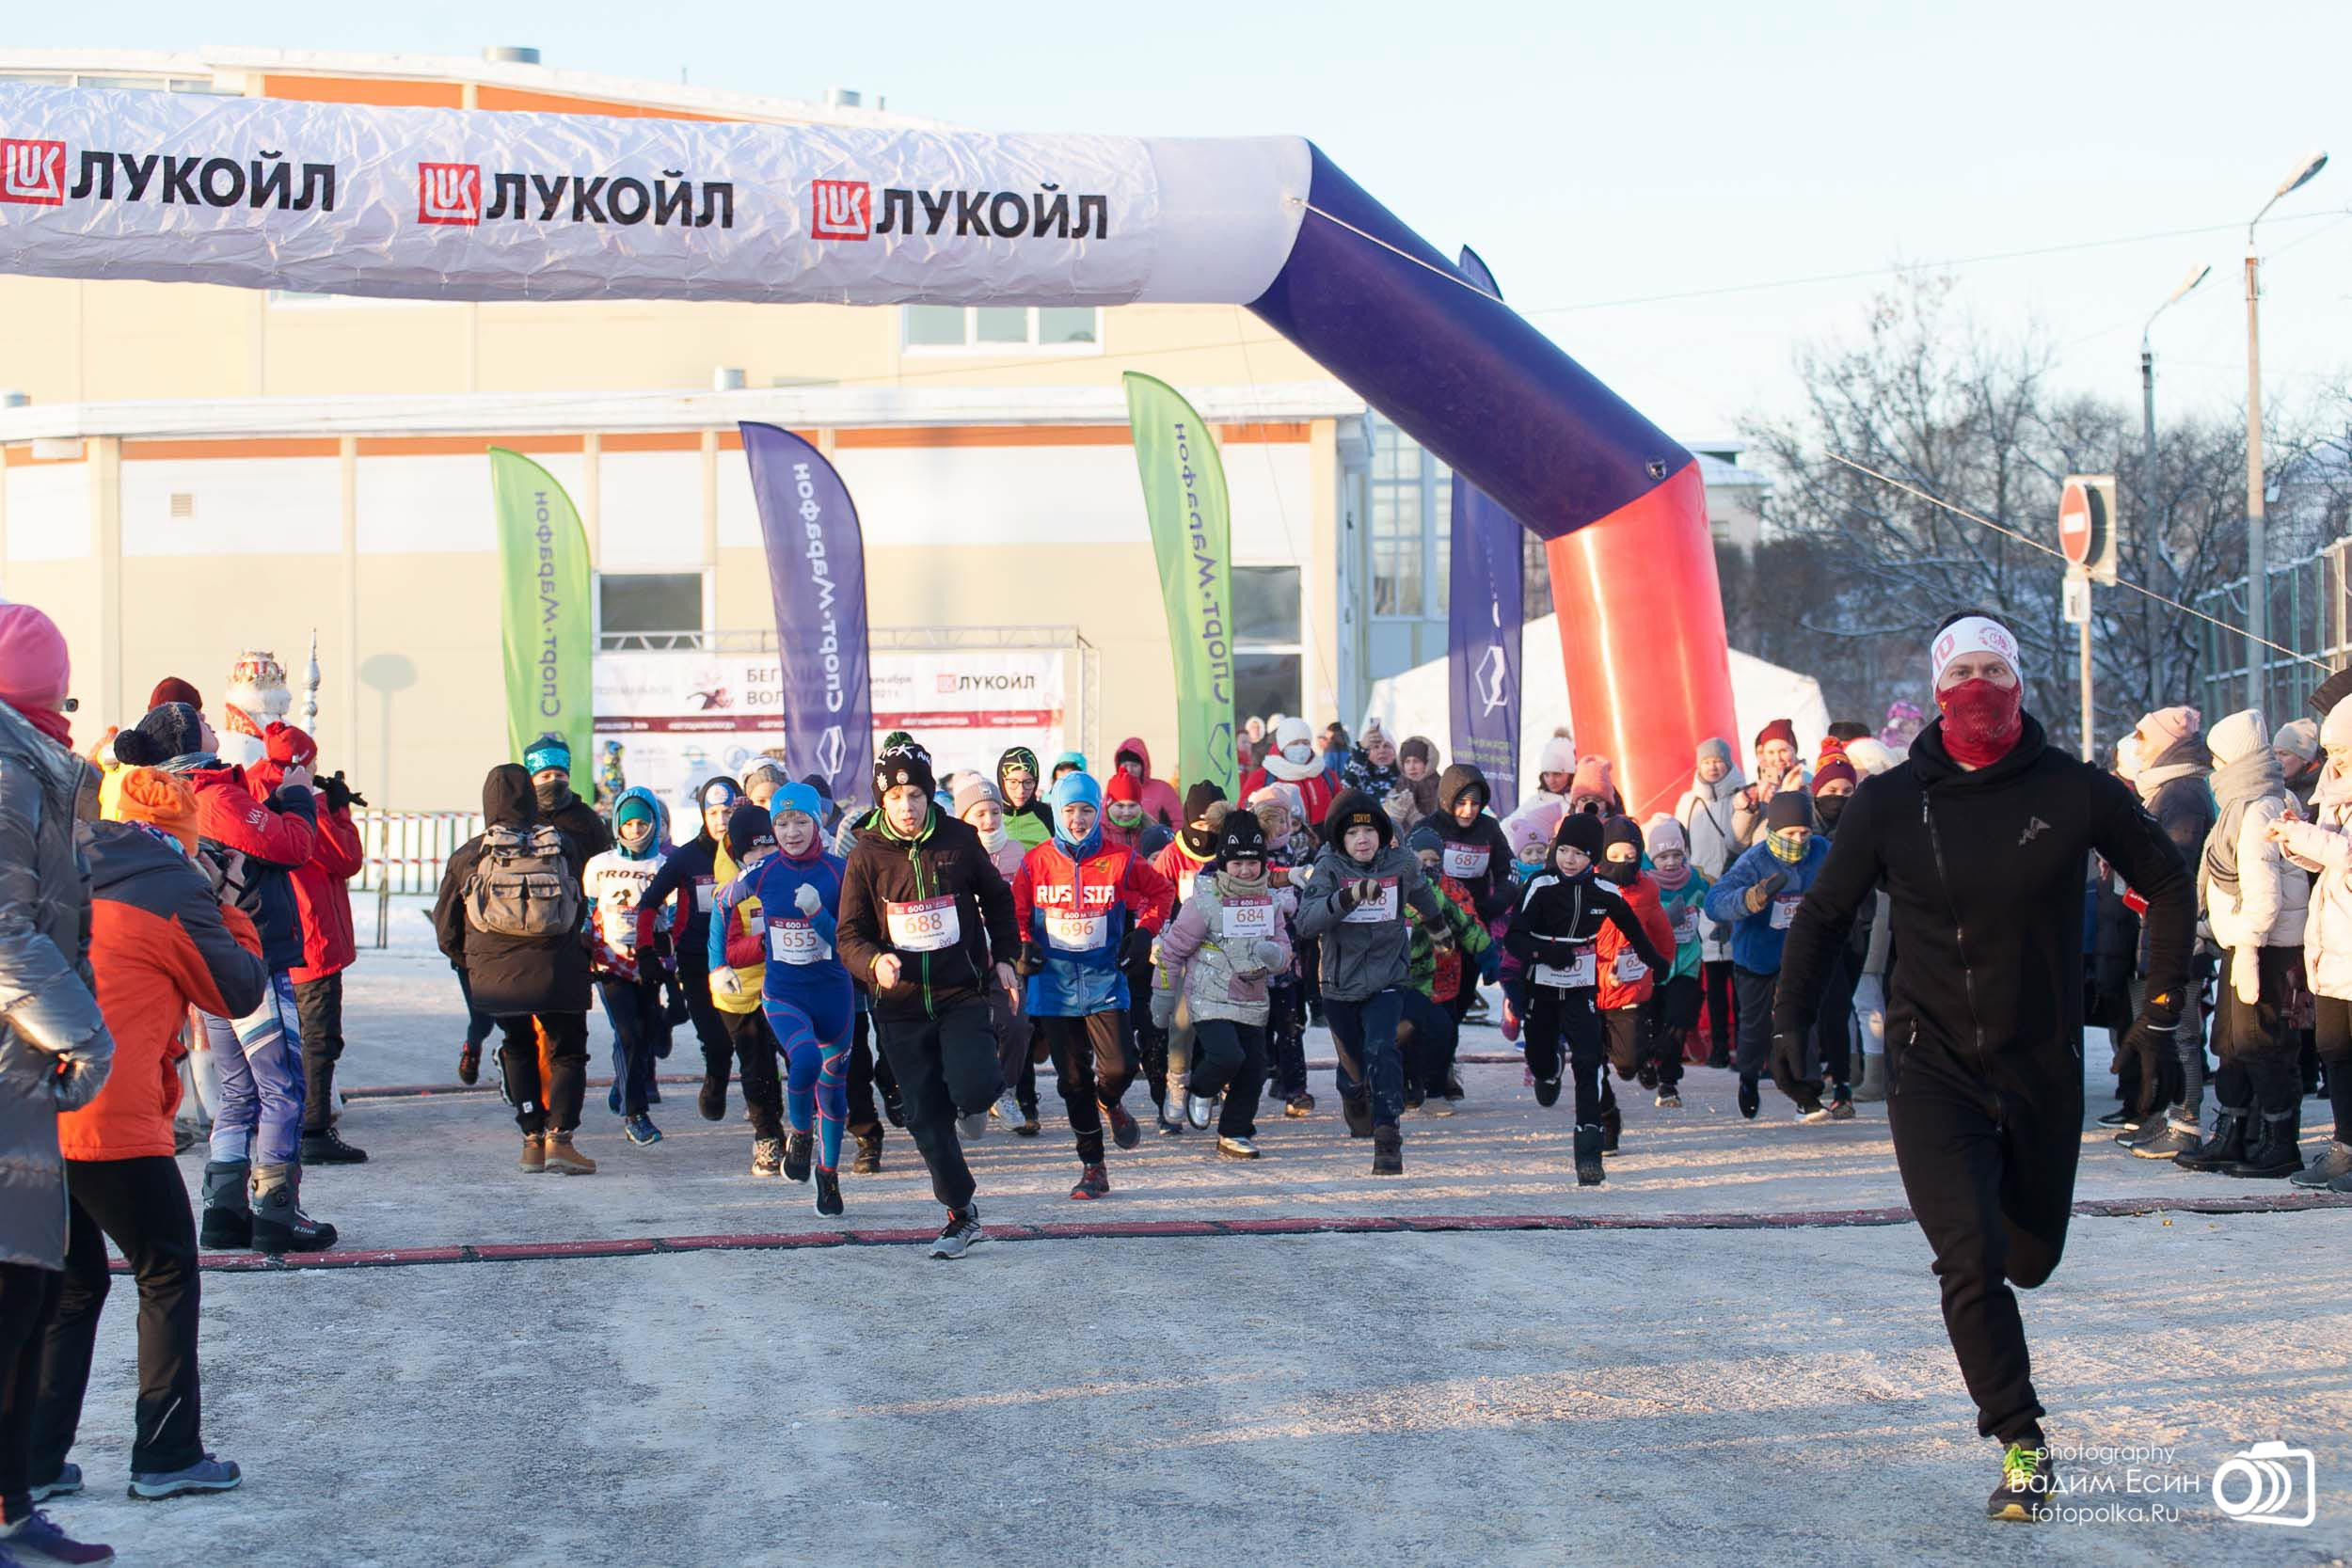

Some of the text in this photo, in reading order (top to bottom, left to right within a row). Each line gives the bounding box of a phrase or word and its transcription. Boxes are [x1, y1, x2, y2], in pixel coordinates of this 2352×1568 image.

[71, 150, 336, 212] ЛУКОЙЛ
[486, 169, 734, 229] ЛУКОЙЛ
[876, 182, 1108, 240] ЛУКОЙЛ
[958, 672, 1038, 690] ЛУКОЙЛ
[1454, 853, 1480, 866] 687
[907, 904, 925, 914] 600
[1236, 908, 1264, 923] 684
[904, 912, 943, 934] 688
[1060, 920, 1094, 936] 696
[783, 931, 818, 947] 655
